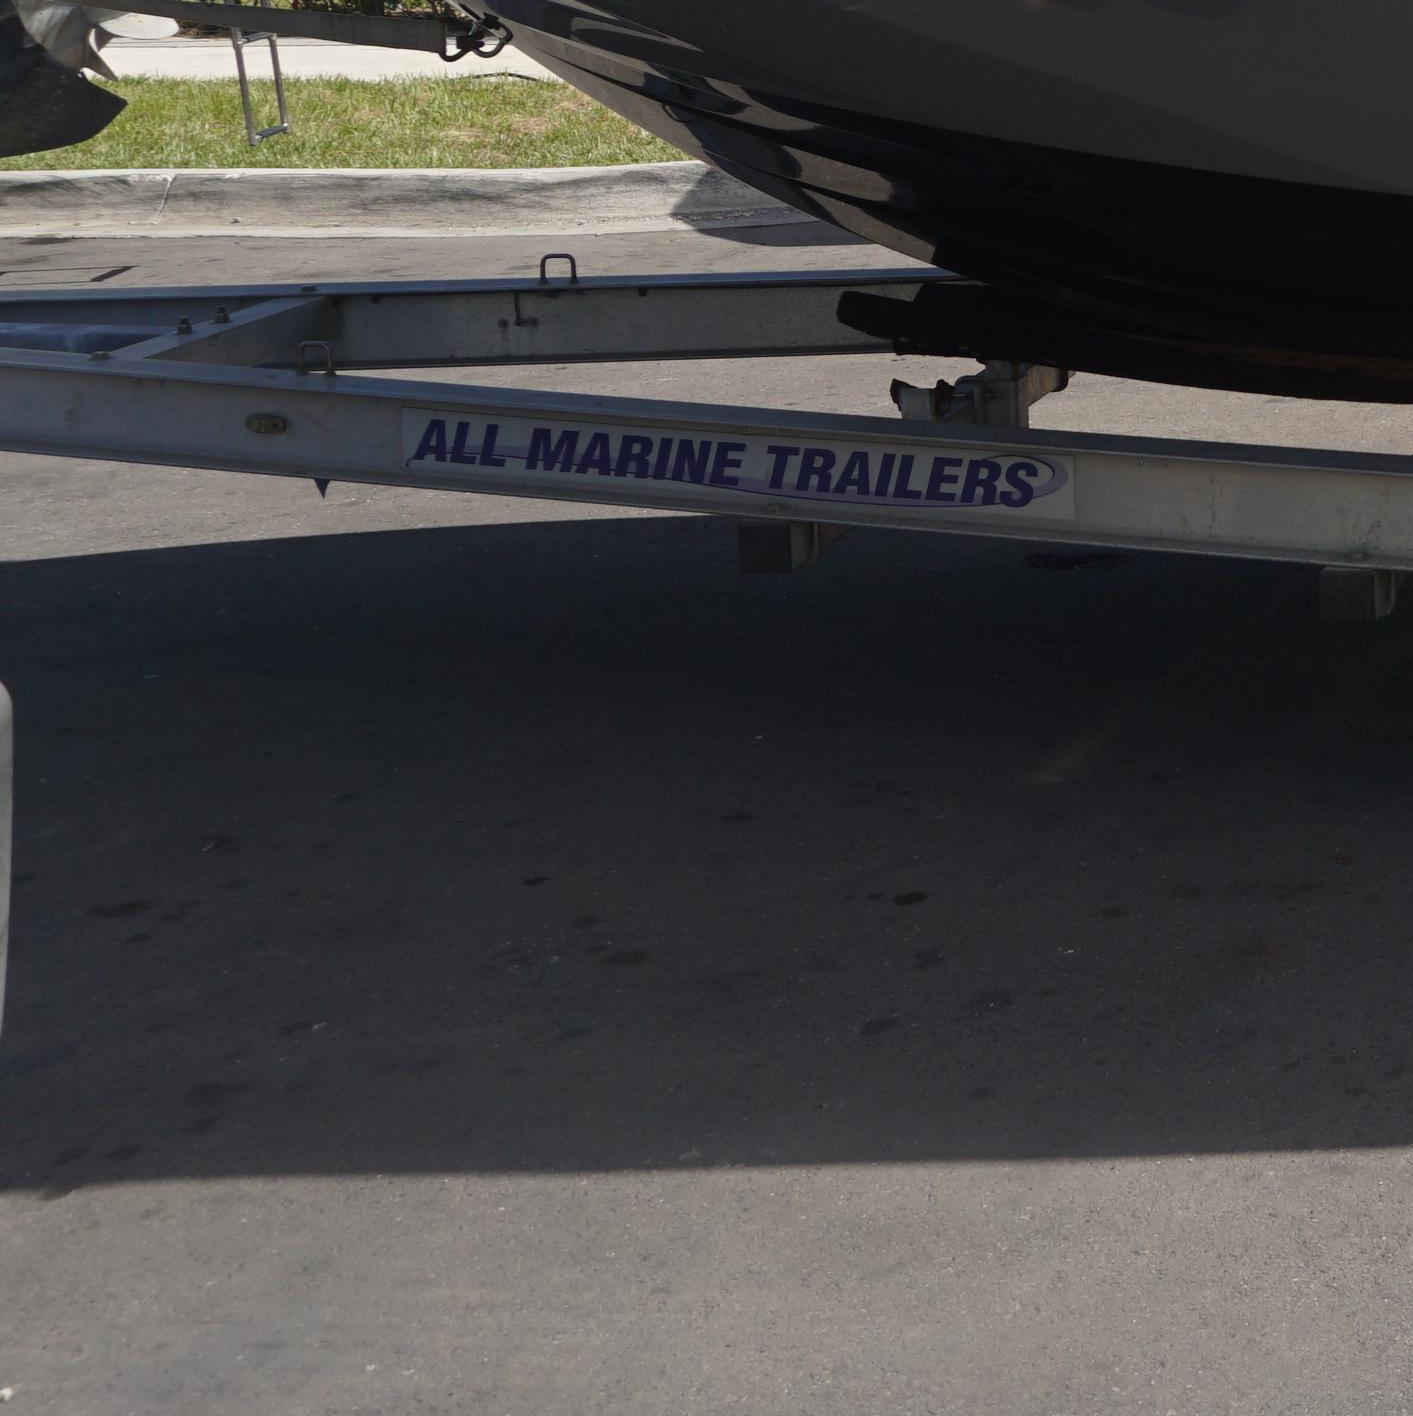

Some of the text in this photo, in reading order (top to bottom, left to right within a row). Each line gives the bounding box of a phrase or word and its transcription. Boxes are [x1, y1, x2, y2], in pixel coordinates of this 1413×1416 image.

[412, 418, 1040, 509] ALL MARINE TRAILERS
